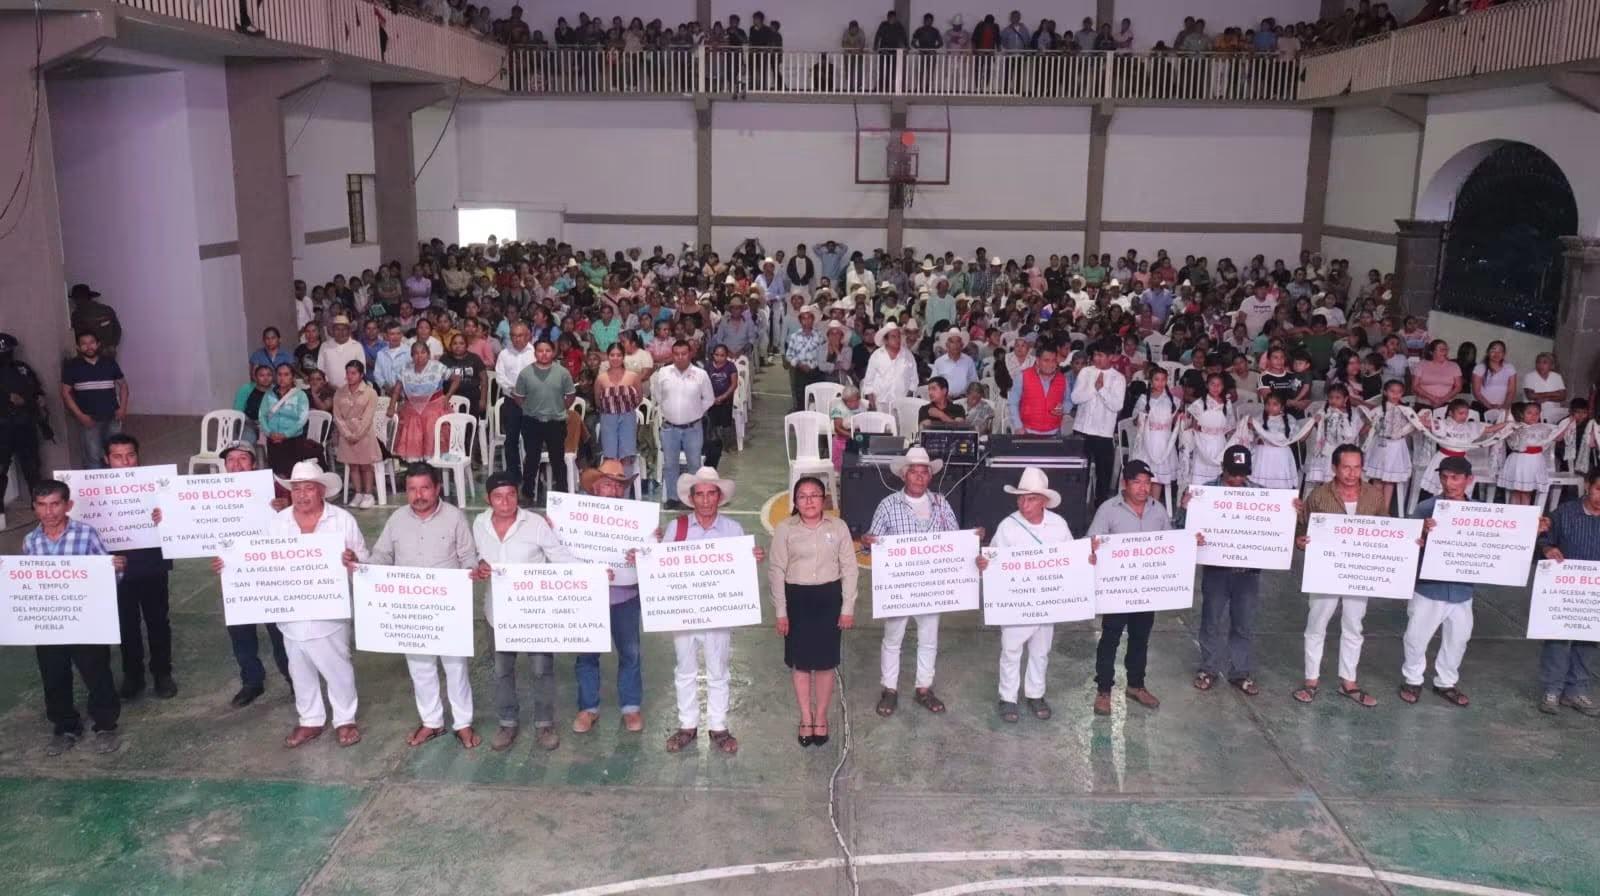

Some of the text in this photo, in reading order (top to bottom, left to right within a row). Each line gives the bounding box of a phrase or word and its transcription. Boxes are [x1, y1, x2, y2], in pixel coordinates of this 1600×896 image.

[85, 472, 120, 480] ENTREGA
[79, 484, 155, 497] 500 BLOCKS
[178, 489, 252, 500] 500 BLOCKS
[1214, 501, 1280, 512] 500 BLOCKS
[570, 512, 639, 529] 500 BLOCKS
[1473, 518, 1517, 528] BLOCKS
[1358, 528, 1404, 538] BLOCKS
[897, 536, 927, 544] ENTREGA
[245, 548, 323, 561] 500 BLOCKS
[888, 544, 954, 557] 500 BLOCKS
[1112, 546, 1175, 558] 500 BLOCKS
[660, 553, 733, 566] 500 BLOCKS
[1024, 558, 1069, 570] BLOCKS
[1348, 564, 1385, 572] MUNICIPIO
[10, 570, 88, 580] 500 BLOCKS
[375, 584, 448, 596] 500 BLOCKS
[513, 580, 588, 590] 500 BLOCKS
